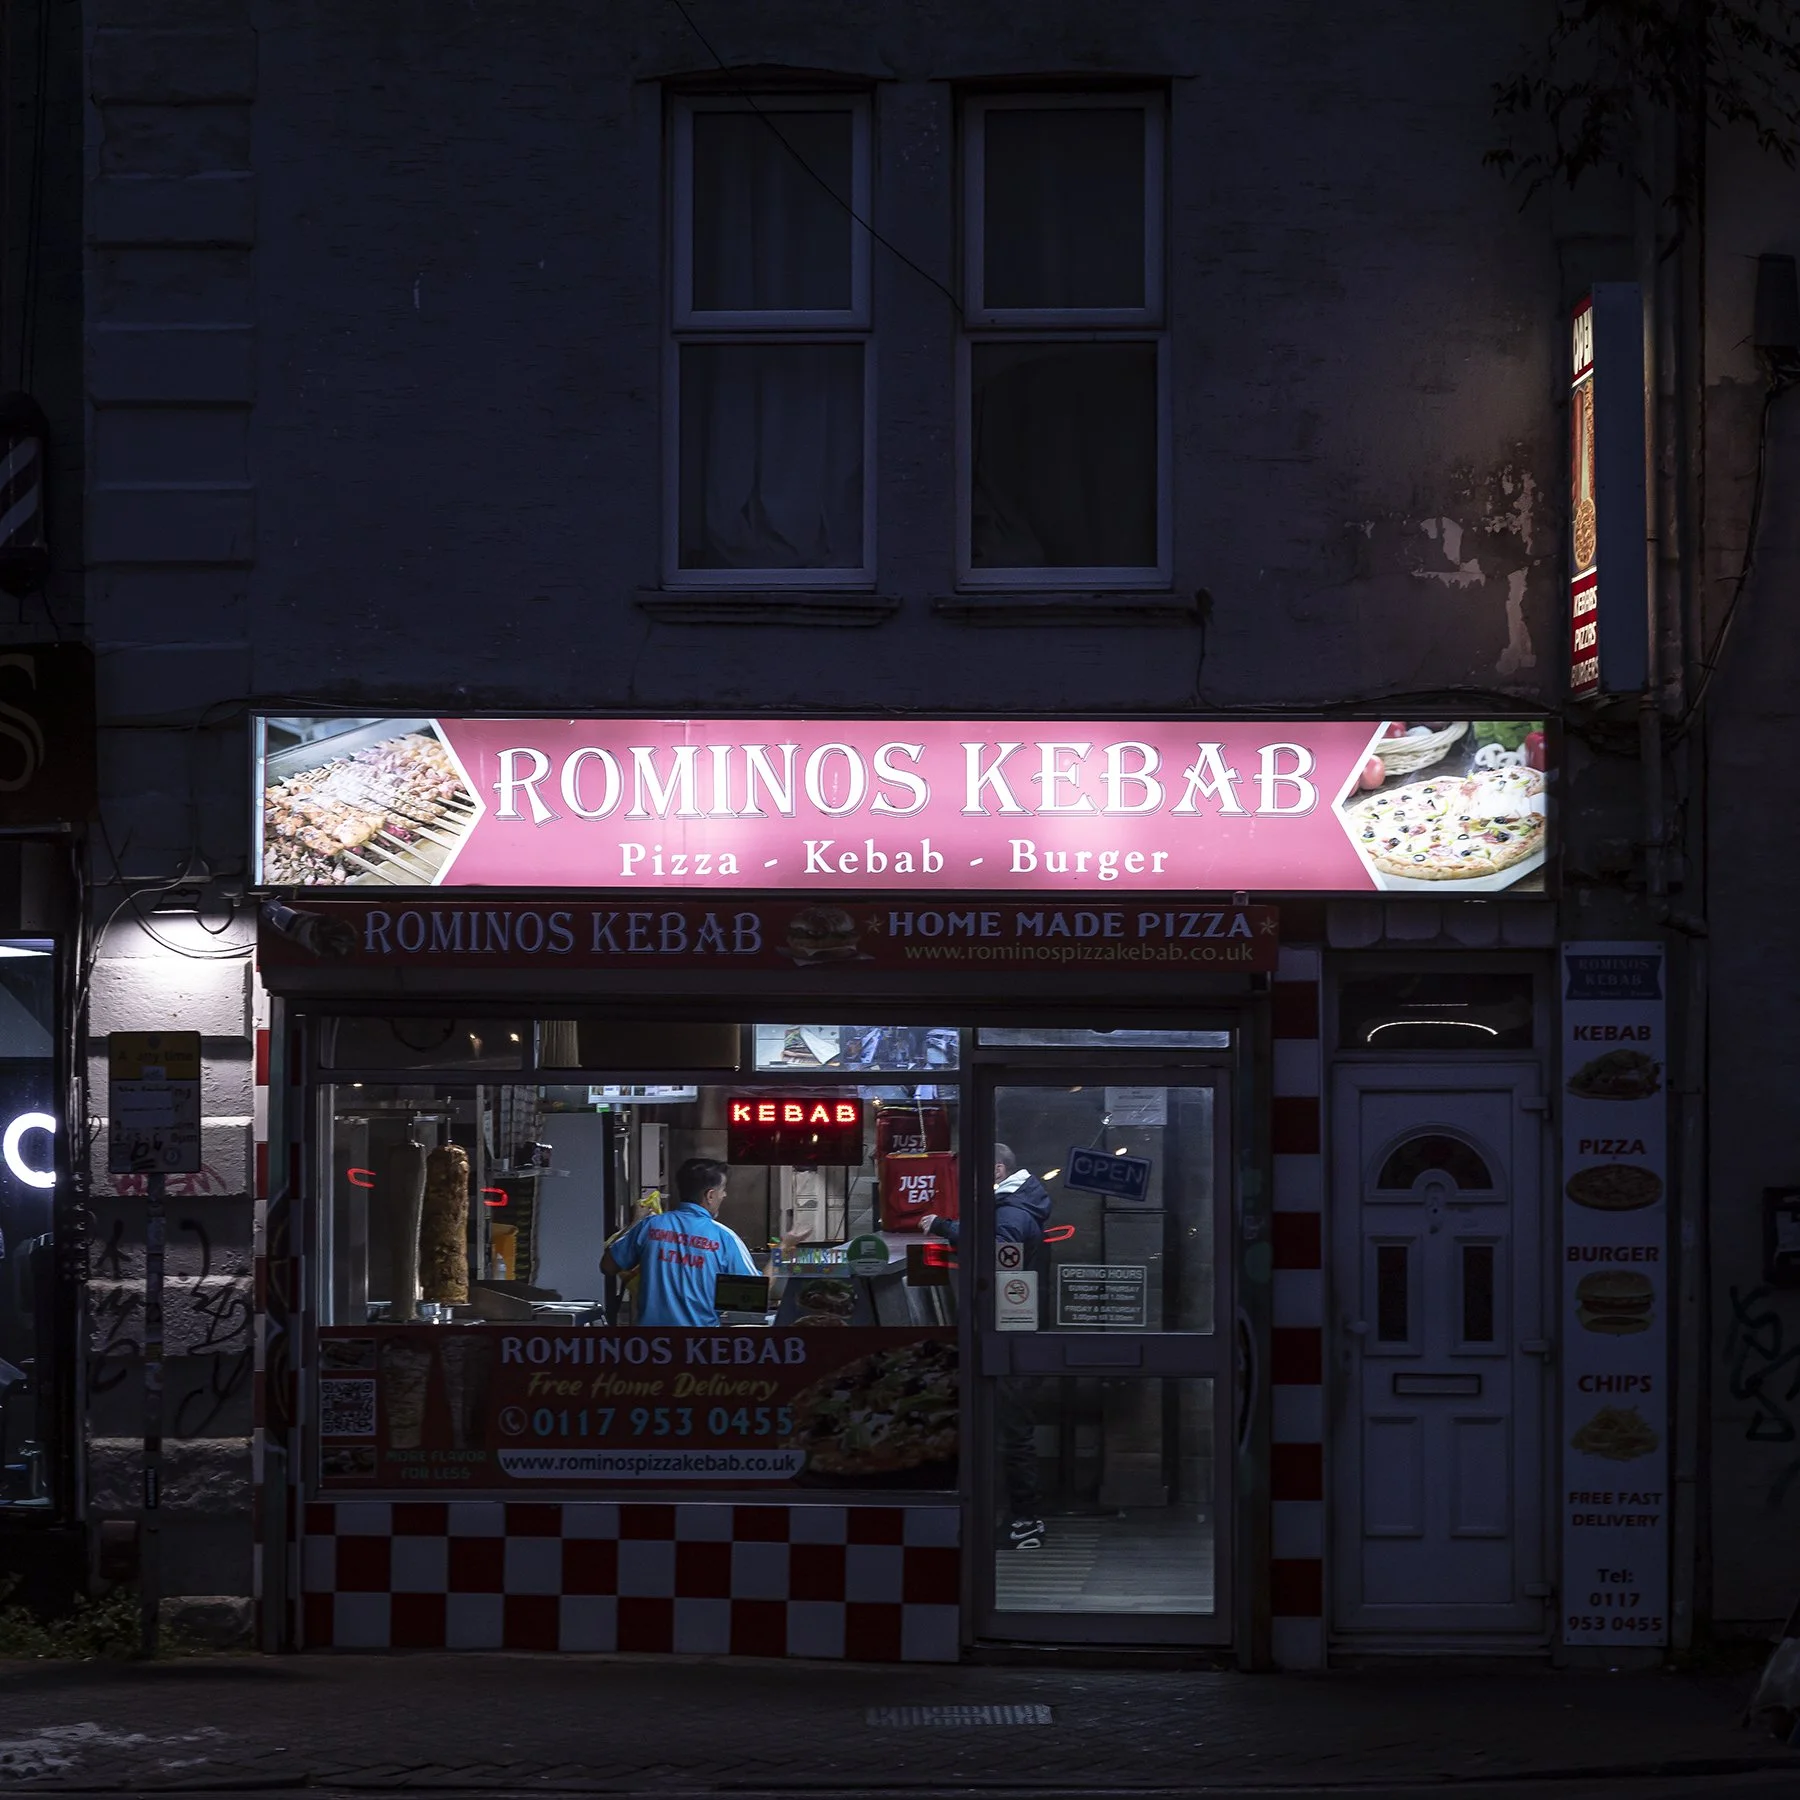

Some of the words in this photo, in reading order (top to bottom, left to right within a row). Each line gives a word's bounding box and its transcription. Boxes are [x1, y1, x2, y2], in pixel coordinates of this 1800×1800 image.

[494, 742, 930, 828] ROMINOS
[960, 741, 1320, 818] KEBAB
[619, 843, 740, 877] Pizza
[803, 838, 945, 875] Kebab
[1009, 839, 1169, 881] Burger
[364, 911, 575, 955] ROMINOS
[590, 911, 763, 954] KEBAB
[888, 911, 1001, 938] HOME
[1015, 911, 1125, 938] MADE
[1137, 911, 1254, 938] PIZZA
[904, 942, 1254, 964] www.rominospizzakebab.co.uk
[1573, 1025, 1652, 1041] KEBAB
[732, 1103, 856, 1123] KEBAB
[1578, 1139, 1647, 1155] PIZZA
[1074, 1156, 1144, 1184] OPEN
[898, 1175, 937, 1192] JUST
[1566, 1246, 1660, 1262] BURGER
[1062, 1268, 1106, 1279] OPENING
[1108, 1269, 1143, 1280] HOURS
[501, 1336, 672, 1365] ROMINOS
[685, 1336, 807, 1365] KEBAB
[527, 1372, 584, 1397] Free
[591, 1372, 663, 1397] Home
[672, 1372, 779, 1402] Delivery
[1578, 1374, 1652, 1393] CHIPS
[532, 1407, 616, 1436] 0117
[629, 1407, 694, 1436] 953
[708, 1407, 795, 1436] 0455
[503, 1454, 796, 1476] www.rominospizzakebab.co.uk
[1569, 1492, 1612, 1505] FREE
[1618, 1492, 1664, 1506] FAST
[1571, 1514, 1661, 1527] DELIVERY
[1598, 1568, 1634, 1583] Tel:
[1589, 1593, 1641, 1607] 0117
[1568, 1616, 1605, 1631] 953
[1611, 1616, 1663, 1632] 0455
